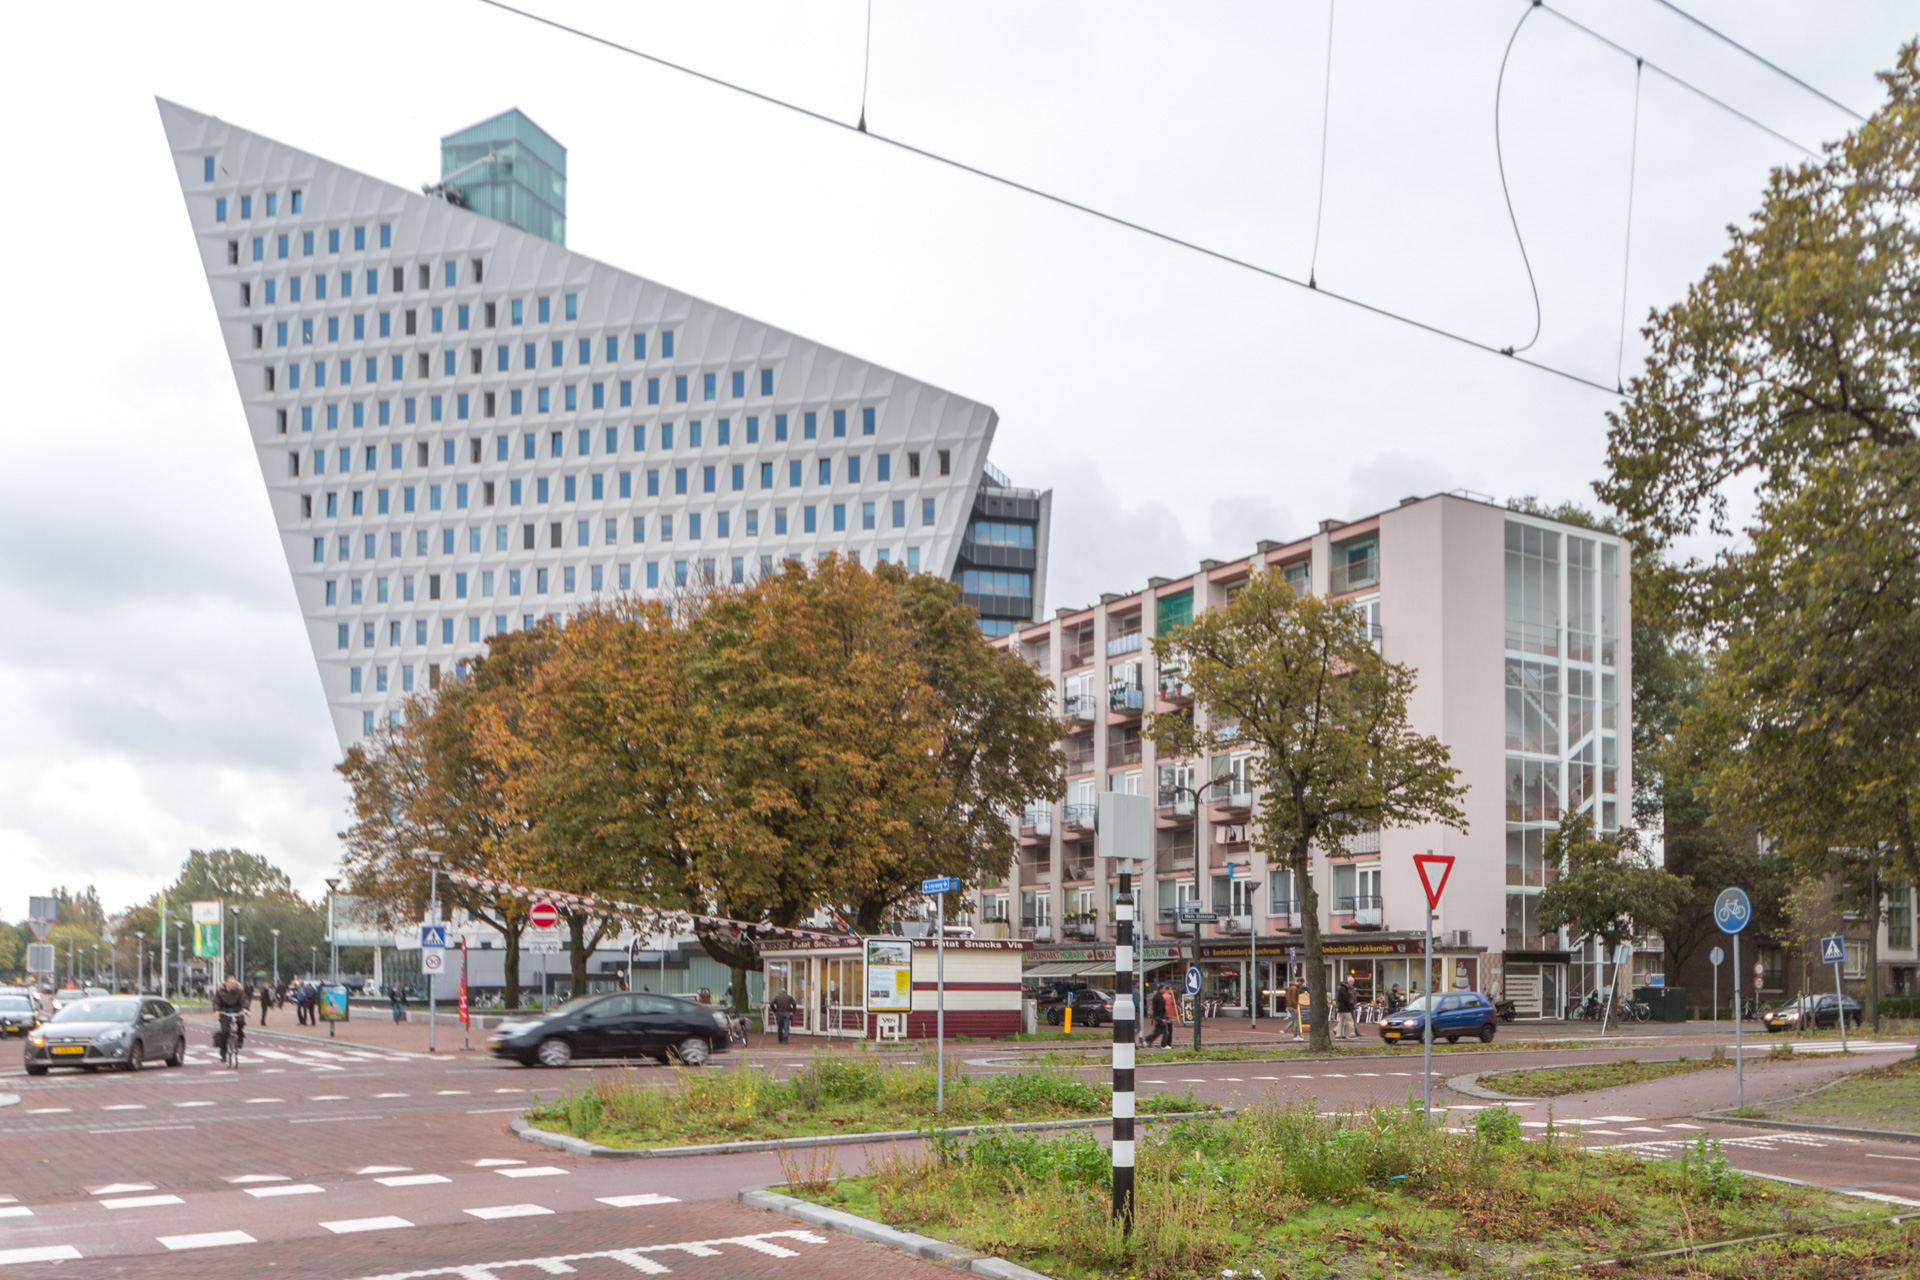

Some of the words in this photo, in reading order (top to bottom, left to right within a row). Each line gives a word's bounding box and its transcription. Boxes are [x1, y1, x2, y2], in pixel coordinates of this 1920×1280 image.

[964, 940, 1002, 949] Snacks
[1007, 941, 1023, 949] Vis
[1254, 947, 1280, 955] unchroom
[1360, 945, 1394, 954] Lekkernijen
[1026, 951, 1060, 960] SUPERMARKT
[1060, 951, 1085, 959] MOBARIK
